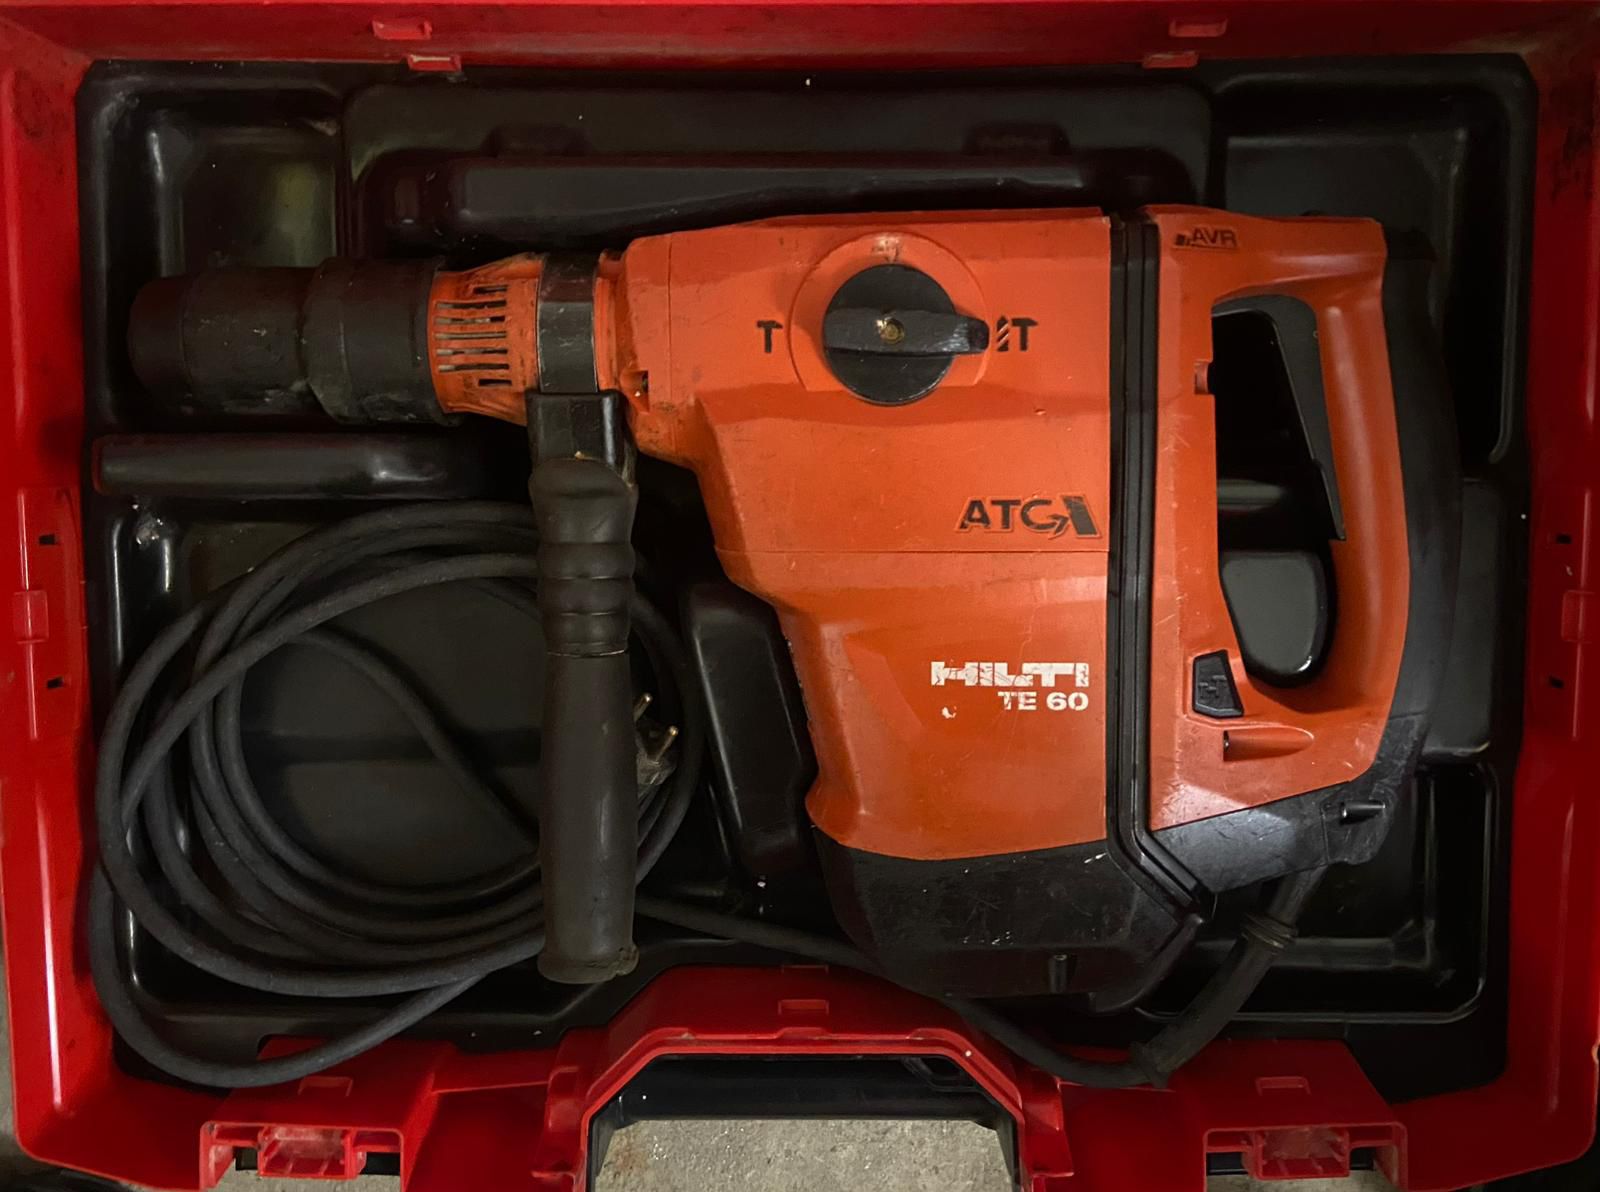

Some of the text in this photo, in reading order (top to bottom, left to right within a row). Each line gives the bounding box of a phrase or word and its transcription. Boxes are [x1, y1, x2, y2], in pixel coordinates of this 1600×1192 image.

[1193, 226, 1237, 247] AVR
[930, 661, 1089, 687] HILTI
[997, 691, 1089, 711] TE 60
